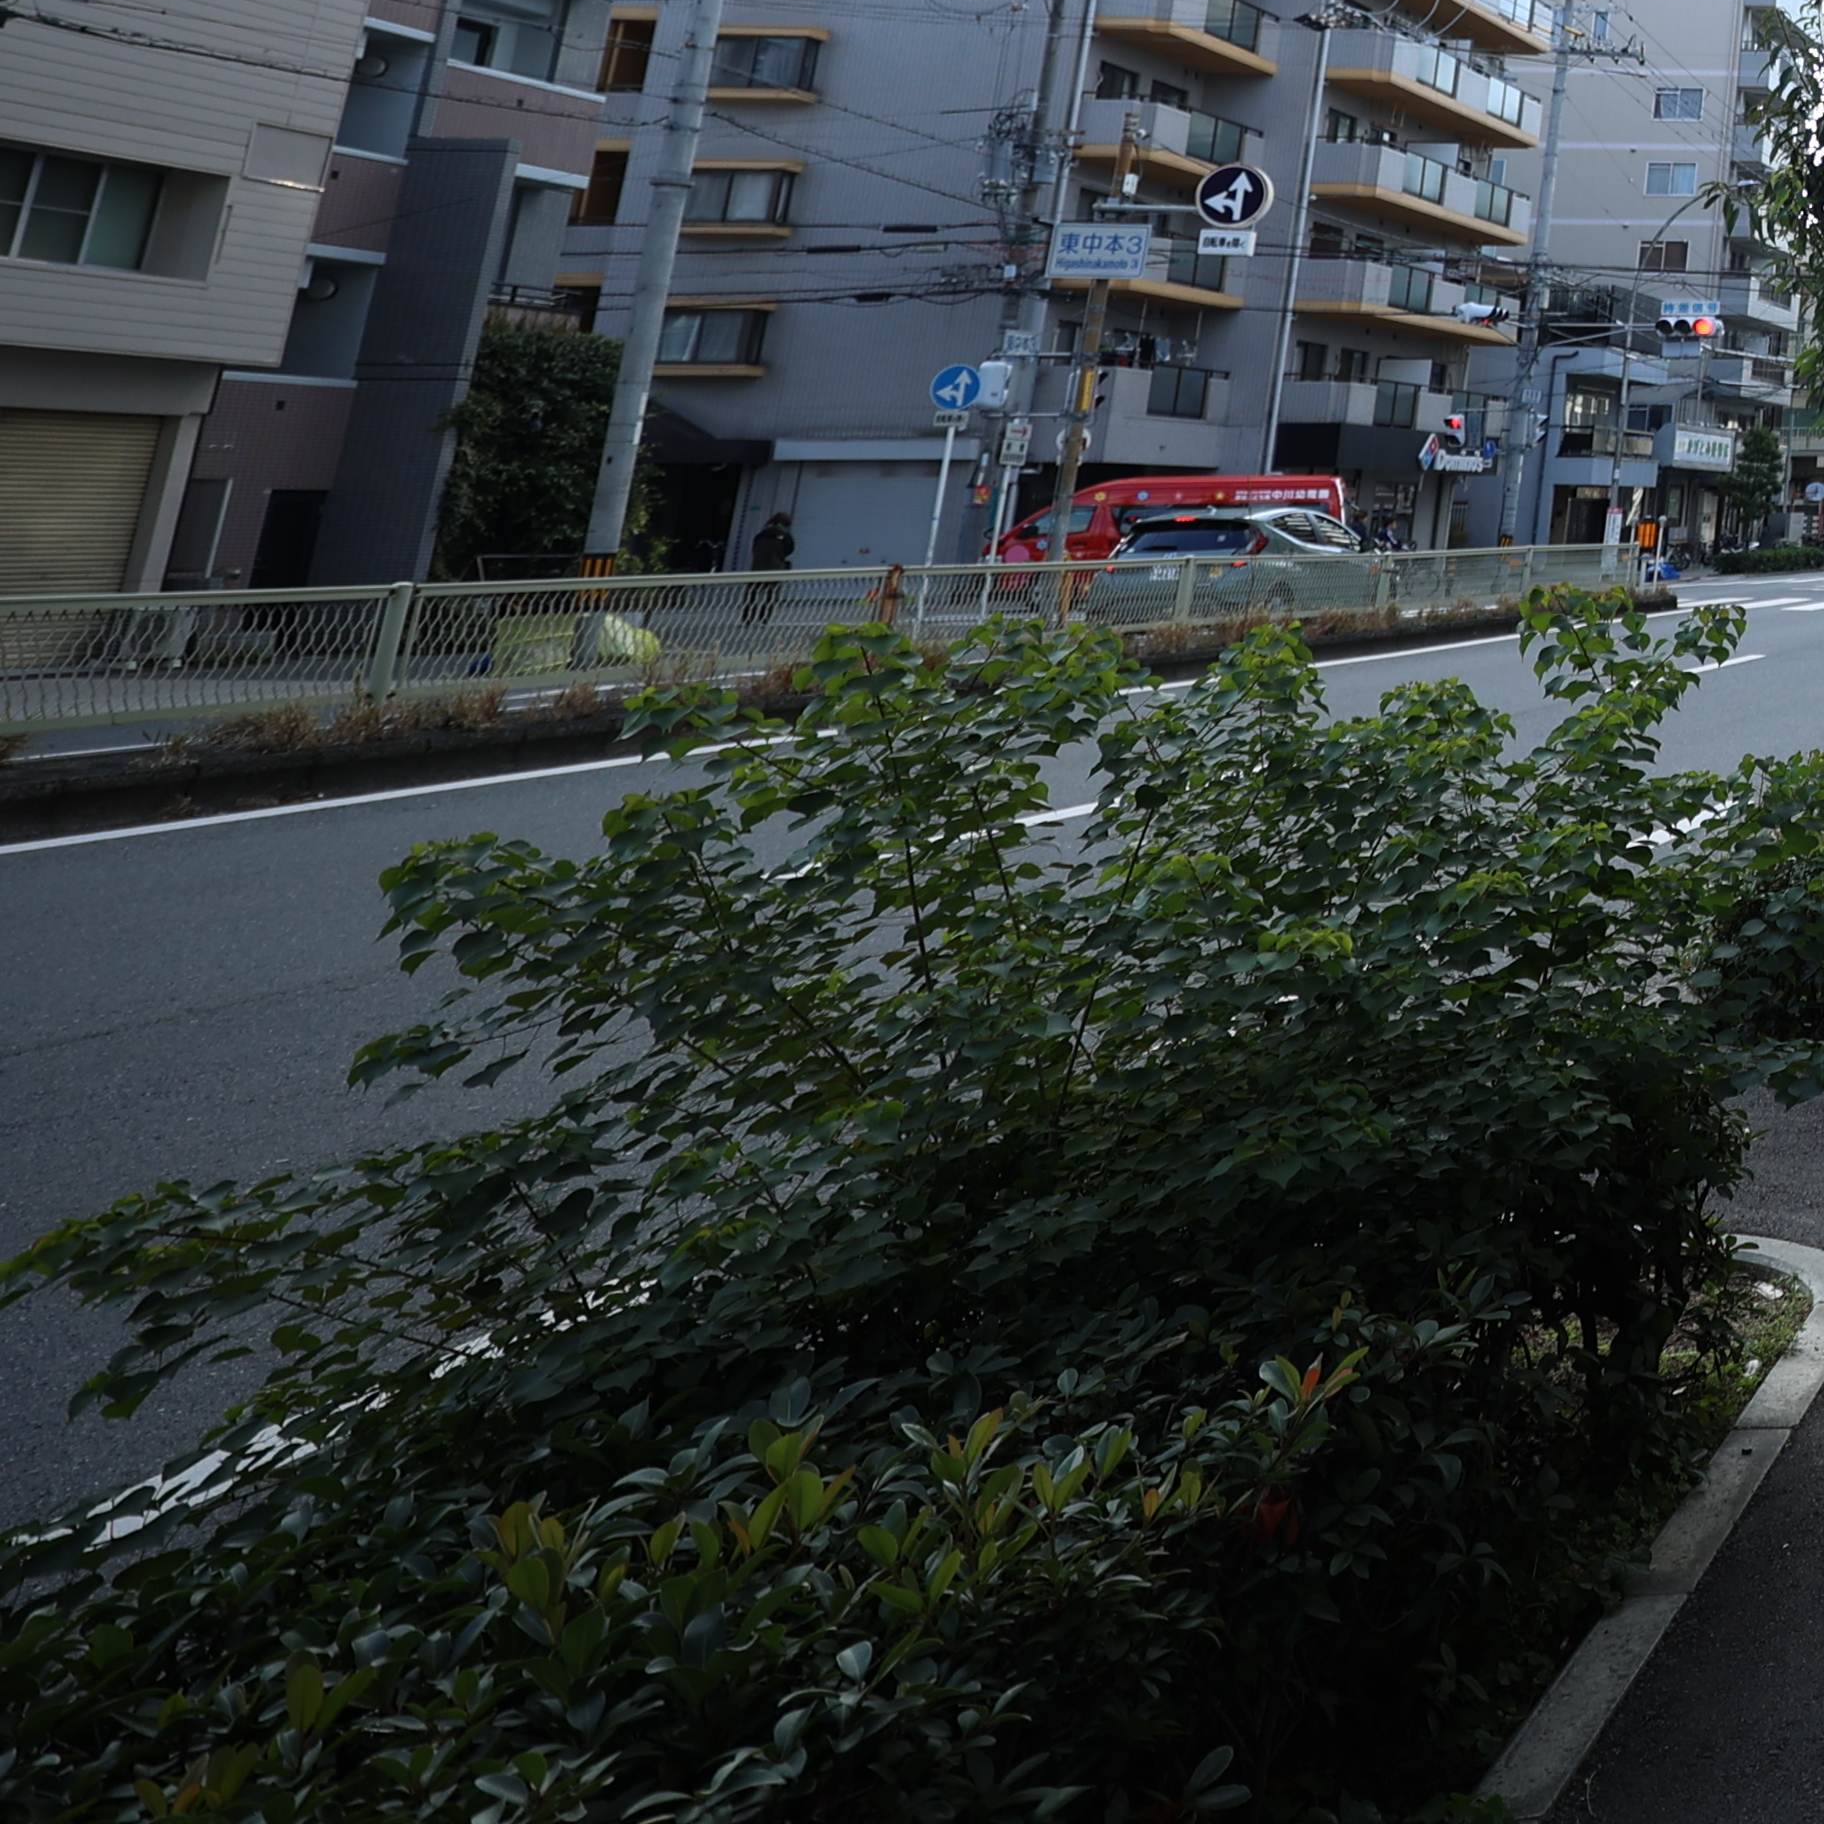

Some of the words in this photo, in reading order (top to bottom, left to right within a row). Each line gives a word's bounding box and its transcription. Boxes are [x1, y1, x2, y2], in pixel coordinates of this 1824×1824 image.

[1057, 232, 1143, 255] 東中本3
[1130, 259, 1138, 269] 3
